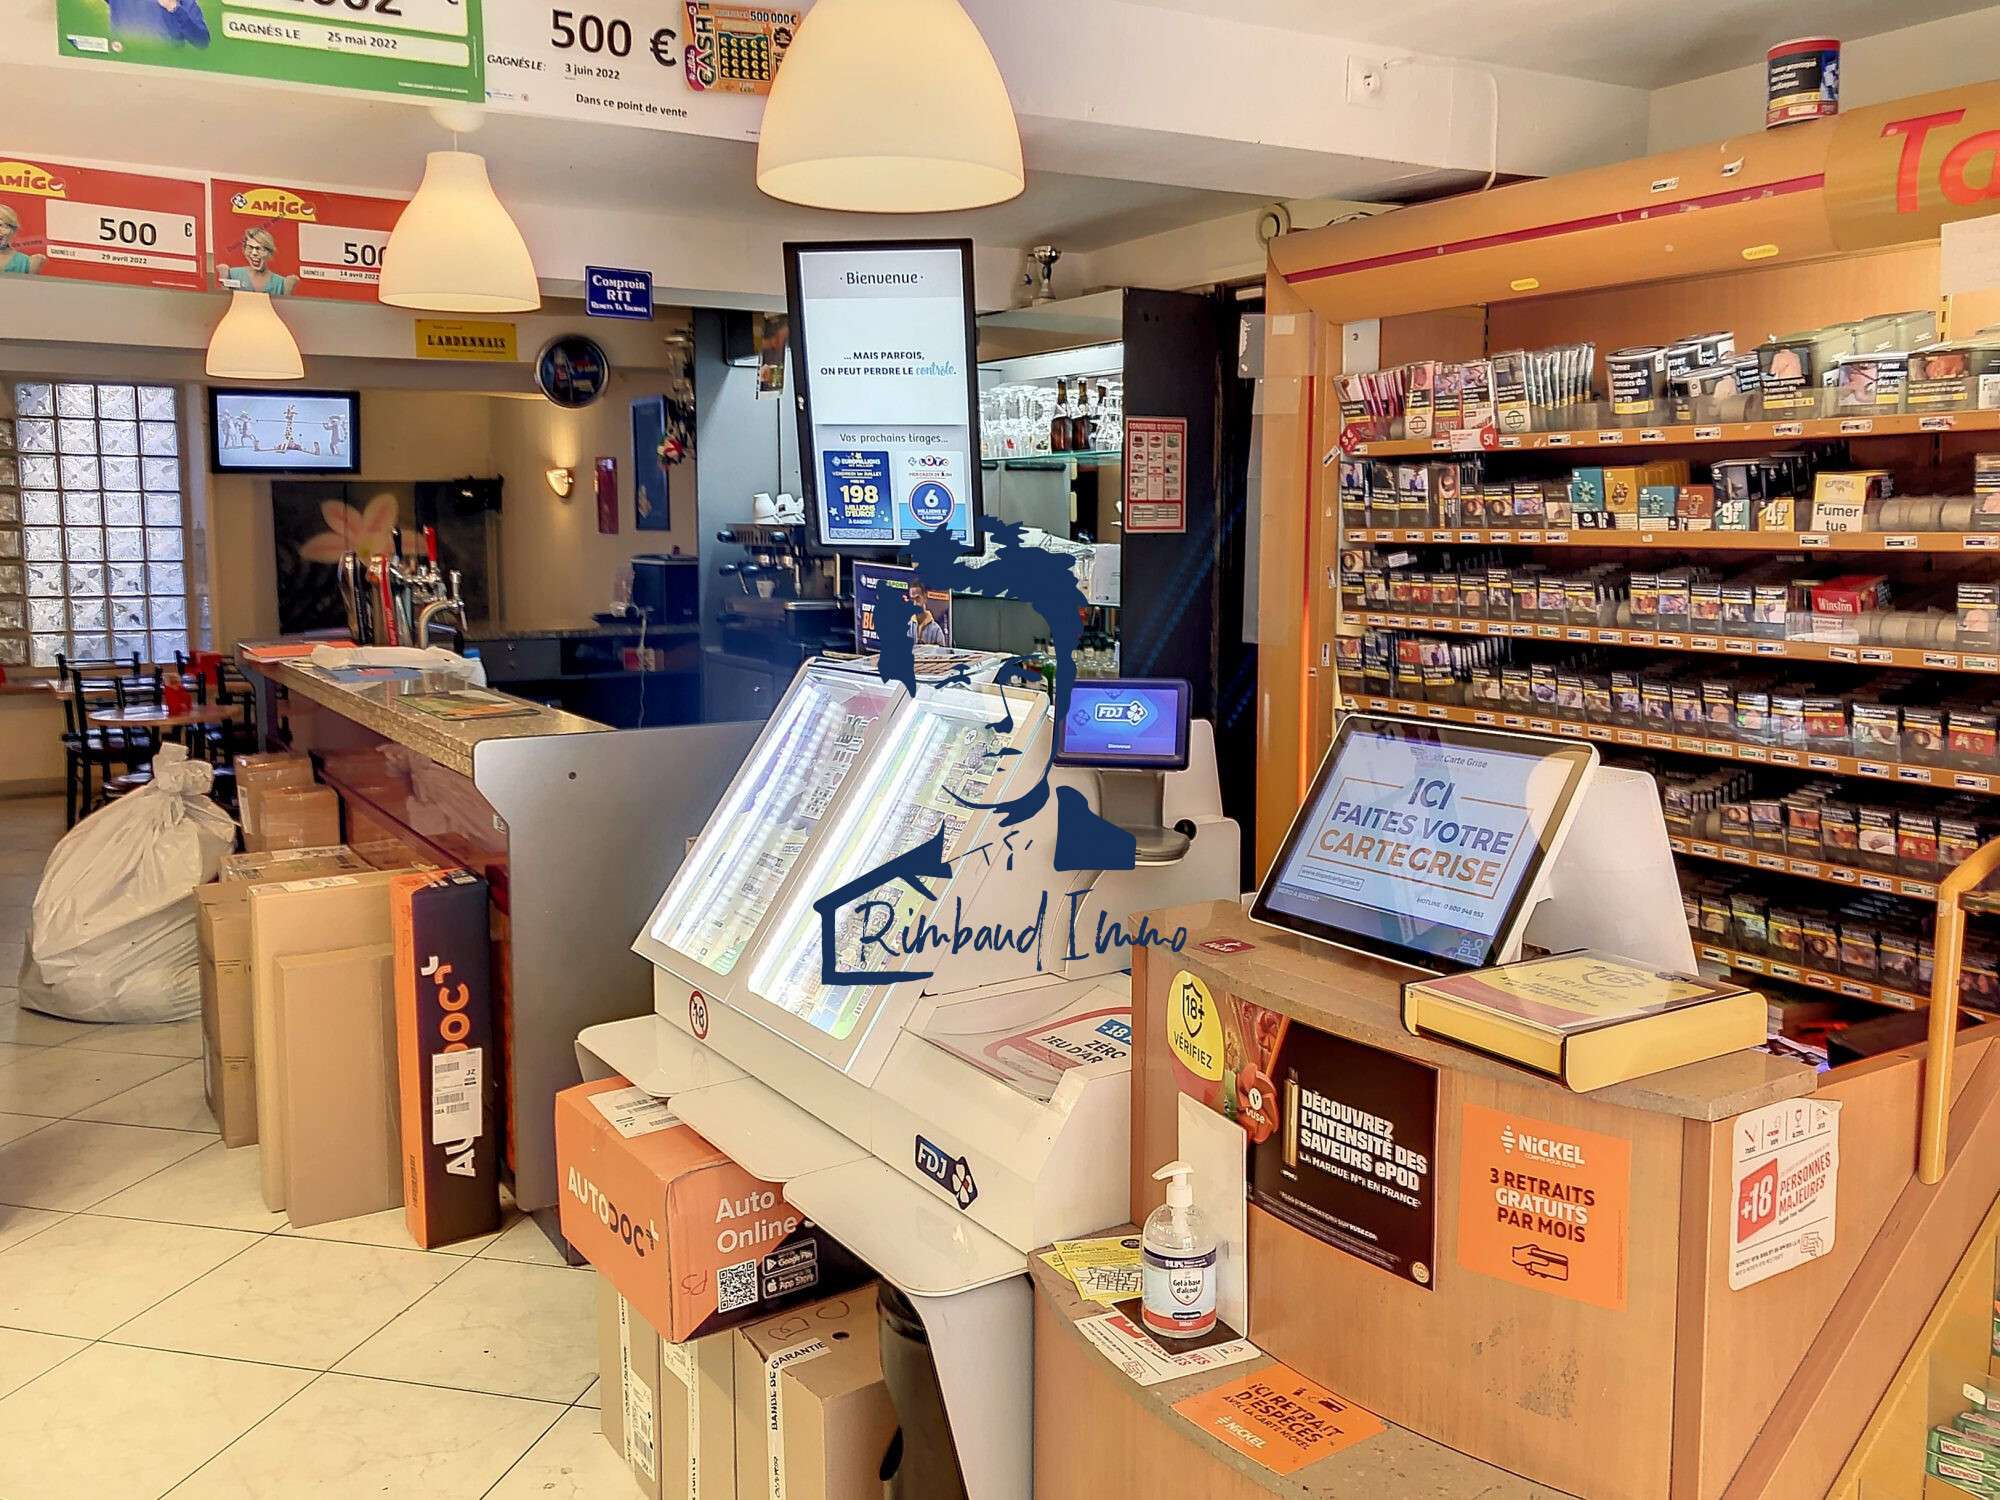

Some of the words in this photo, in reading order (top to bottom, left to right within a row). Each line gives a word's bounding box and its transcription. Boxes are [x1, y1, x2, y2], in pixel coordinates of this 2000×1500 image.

[228, 21, 282, 38] GAGNÉS
[286, 28, 301, 40] LE
[327, 31, 343, 43] 25
[345, 35, 368, 46] mai
[370, 37, 398, 50] 2022
[551, 9, 632, 57] 500
[650, 28, 677, 67] €
[486, 53, 531, 71] GAGNÉS
[565, 63, 572, 73] 3
[573, 65, 593, 78] juin
[595, 68, 621, 80] 2022
[575, 93, 602, 106] Dans
[602, 99, 616, 109] ce
[617, 98, 643, 115] point
[646, 103, 658, 114] de
[659, 106, 689, 119] vente
[99, 217, 157, 246] 500
[184, 222, 193, 238] €
[112, 254, 129, 263] avril
[129, 256, 148, 265] 2022
[348, 271, 363, 279] avril
[364, 273, 380, 281] 2022
[846, 271, 919, 285] Bienvenue
[606, 289, 633, 303] RTT
[820, 367, 836, 376] ON
[837, 367, 862, 376] PEUT
[864, 366, 901, 376] PERDRE
[902, 366, 914, 376] LE
[839, 433, 857, 443] Vos
[860, 433, 906, 446] prochains
[839, 484, 879, 505] 198
[924, 489, 940, 508] 6
[1816, 503, 1860, 518] Fumer
[1826, 519, 1848, 532] tue
[1817, 597, 1853, 612] Winston
[1098, 707, 1124, 718] FDJ
[1444, 755, 1466, 765] Carte
[1407, 777, 1456, 811] ICI
[1331, 802, 1418, 836] FAITES
[1423, 817, 1514, 856] VOTRE
[1318, 829, 1411, 868] CARTE
[1408, 847, 1502, 888] GRISE
[1186, 994, 1205, 1020] 18+
[1041, 1035, 1072, 1049] JEU
[1173, 1030, 1213, 1070] VÉRIFIEZ
[1245, 1106, 1265, 1125] vuse
[1301, 1088, 1394, 1139] DÉCOUVREZ
[1300, 1107, 1393, 1161] L'INTENSITÉ
[1395, 1144, 1429, 1175] DES
[917, 1140, 948, 1181] FDJ
[1299, 1151, 1312, 1164] LA
[1312, 1157, 1350, 1181] MARQUE
[1367, 1179, 1382, 1194] EN
[1300, 1128, 1374, 1173] SAVEURS
[1374, 1160, 1421, 1192] ePOD
[1490, 1167, 1500, 1184] 3
[1504, 1170, 1596, 1207] RETRAITS
[1779, 1151, 1832, 1197] PERSONNES
[715, 1191, 776, 1224] Auto
[1495, 1186, 1589, 1226] GRATUITS
[1740, 1174, 1775, 1224] +18
[1778, 1174, 1826, 1217] MAJEURES
[716, 1216, 798, 1254] Online
[1497, 1207, 1534, 1231] PAR
[1538, 1216, 1586, 1243] MOIS
[779, 1280, 796, 1291] App
[1172, 1279, 1184, 1287] Gel
[1188, 1279, 1201, 1287] base
[1176, 1286, 1199, 1295] d'alcool
[770, 1340, 828, 1371] GARANTIE
[1234, 1391, 1324, 1444] D'ESPÈCES
